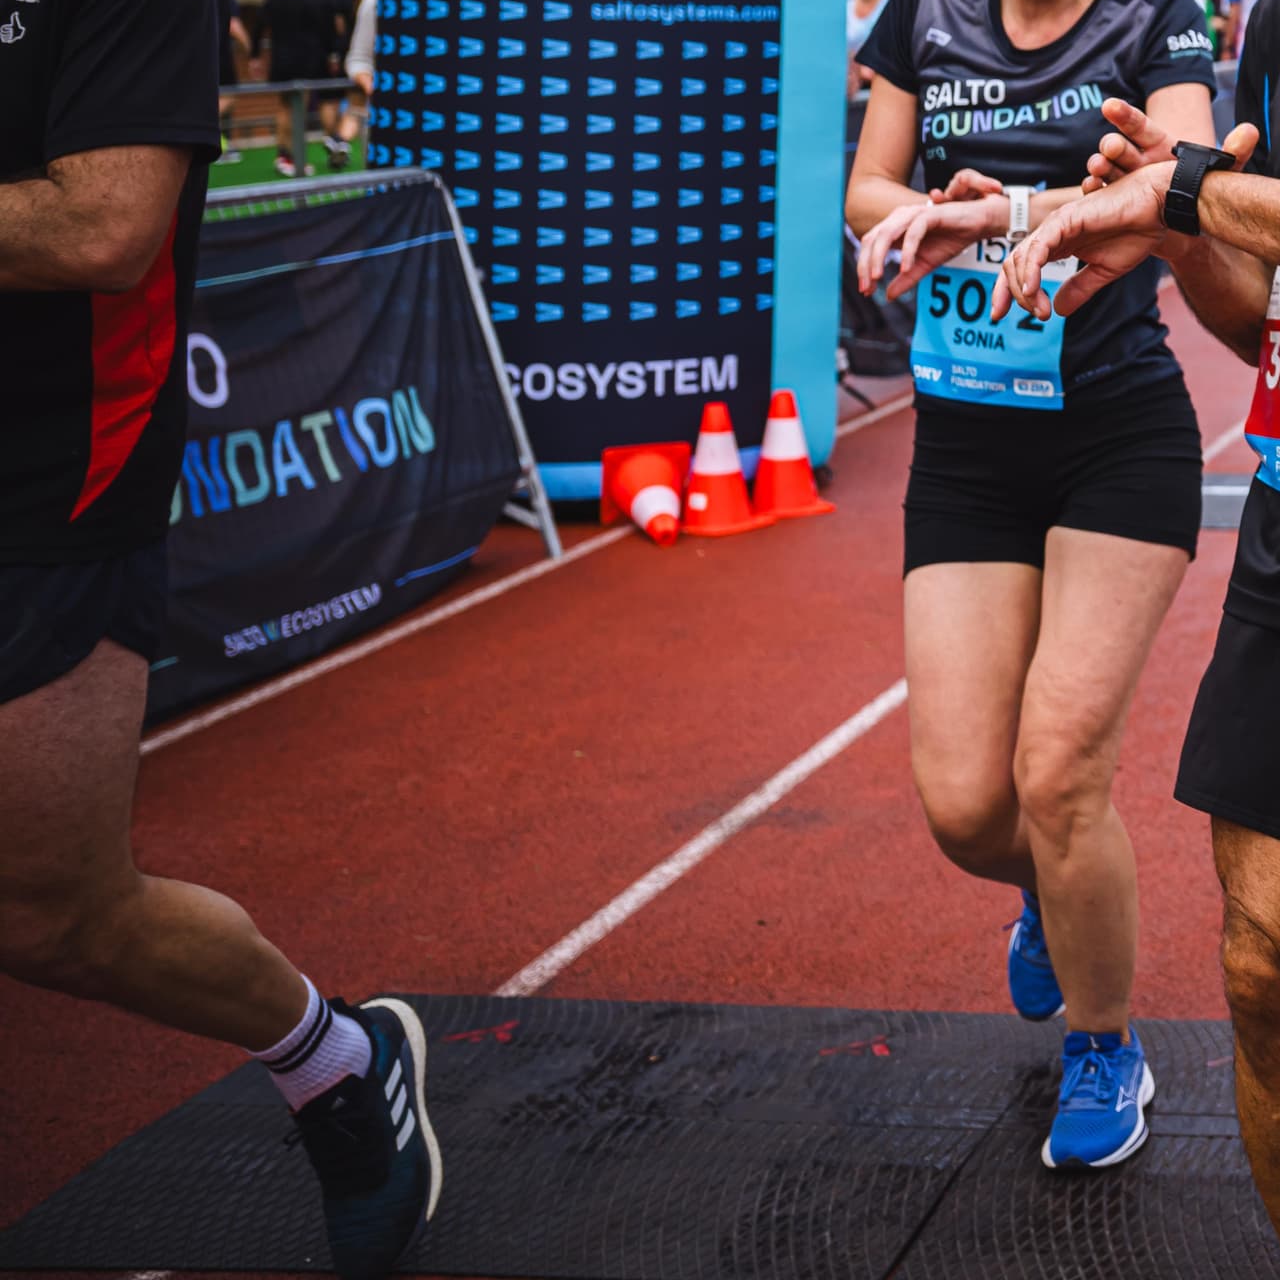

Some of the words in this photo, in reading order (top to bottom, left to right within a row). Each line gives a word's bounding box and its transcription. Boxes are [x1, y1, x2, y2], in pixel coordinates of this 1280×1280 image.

[591, 0, 779, 26] saltosystems.com
[923, 78, 1006, 111] SALTO
[921, 83, 1103, 143] FOUNDATION
[976, 236, 1015, 265] 15
[928, 273, 1050, 333] 502
[953, 328, 1006, 352] SONIA
[169, 385, 437, 524] NDATION
